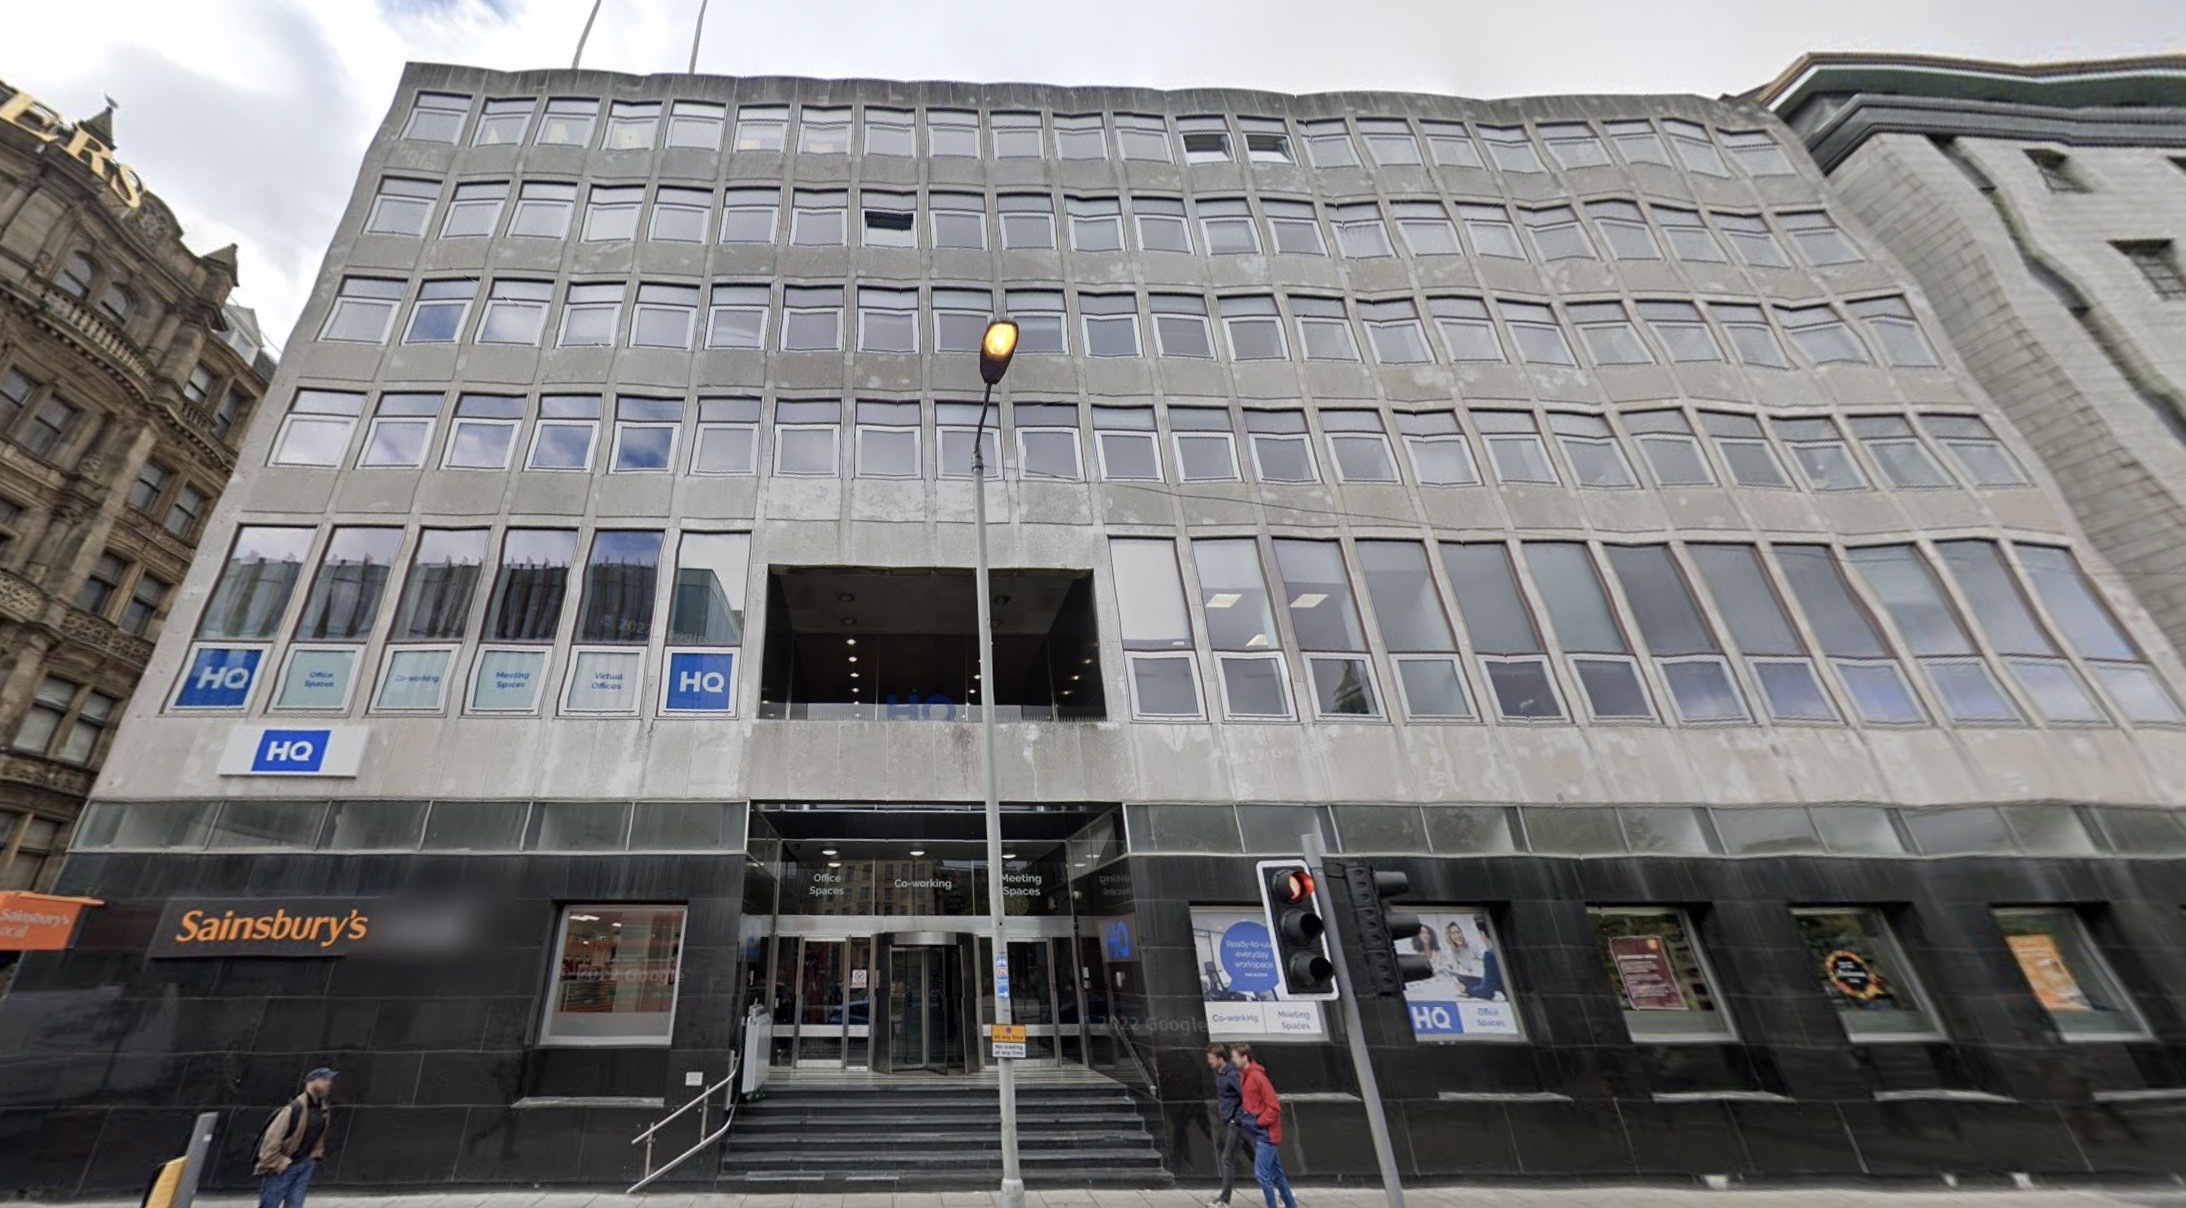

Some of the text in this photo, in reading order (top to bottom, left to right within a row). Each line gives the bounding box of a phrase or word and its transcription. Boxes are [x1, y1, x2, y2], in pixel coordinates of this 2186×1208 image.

[196, 666, 250, 690] HQ
[309, 671, 334, 679] Office
[395, 674, 440, 684] Co-working
[495, 671, 530, 681] Meeting
[594, 671, 624, 680] Virtual
[304, 680, 334, 688] Spaces
[496, 681, 526, 689] Spaces
[591, 681, 622, 690] Offices
[679, 671, 725, 692] HQ
[266, 740, 315, 761] HQ
[813, 873, 842, 883] Office
[1000, 873, 1042, 885] Meeting
[894, 879, 952, 890] Co-working
[809, 886, 845, 897] Spaces
[1002, 886, 1041, 898] Spaces
[175, 908, 370, 947] Sainsbury's
[1105, 920, 1131, 960] HQ
[1235, 951, 1268, 959] everyday
[1234, 960, 1274, 969] workspace
[1212, 1014, 1259, 1023] Co-working
[1278, 1011, 1310, 1020] Meeting
[1411, 1006, 1452, 1029] HQ
[1281, 1022, 1310, 1030] Spaces
